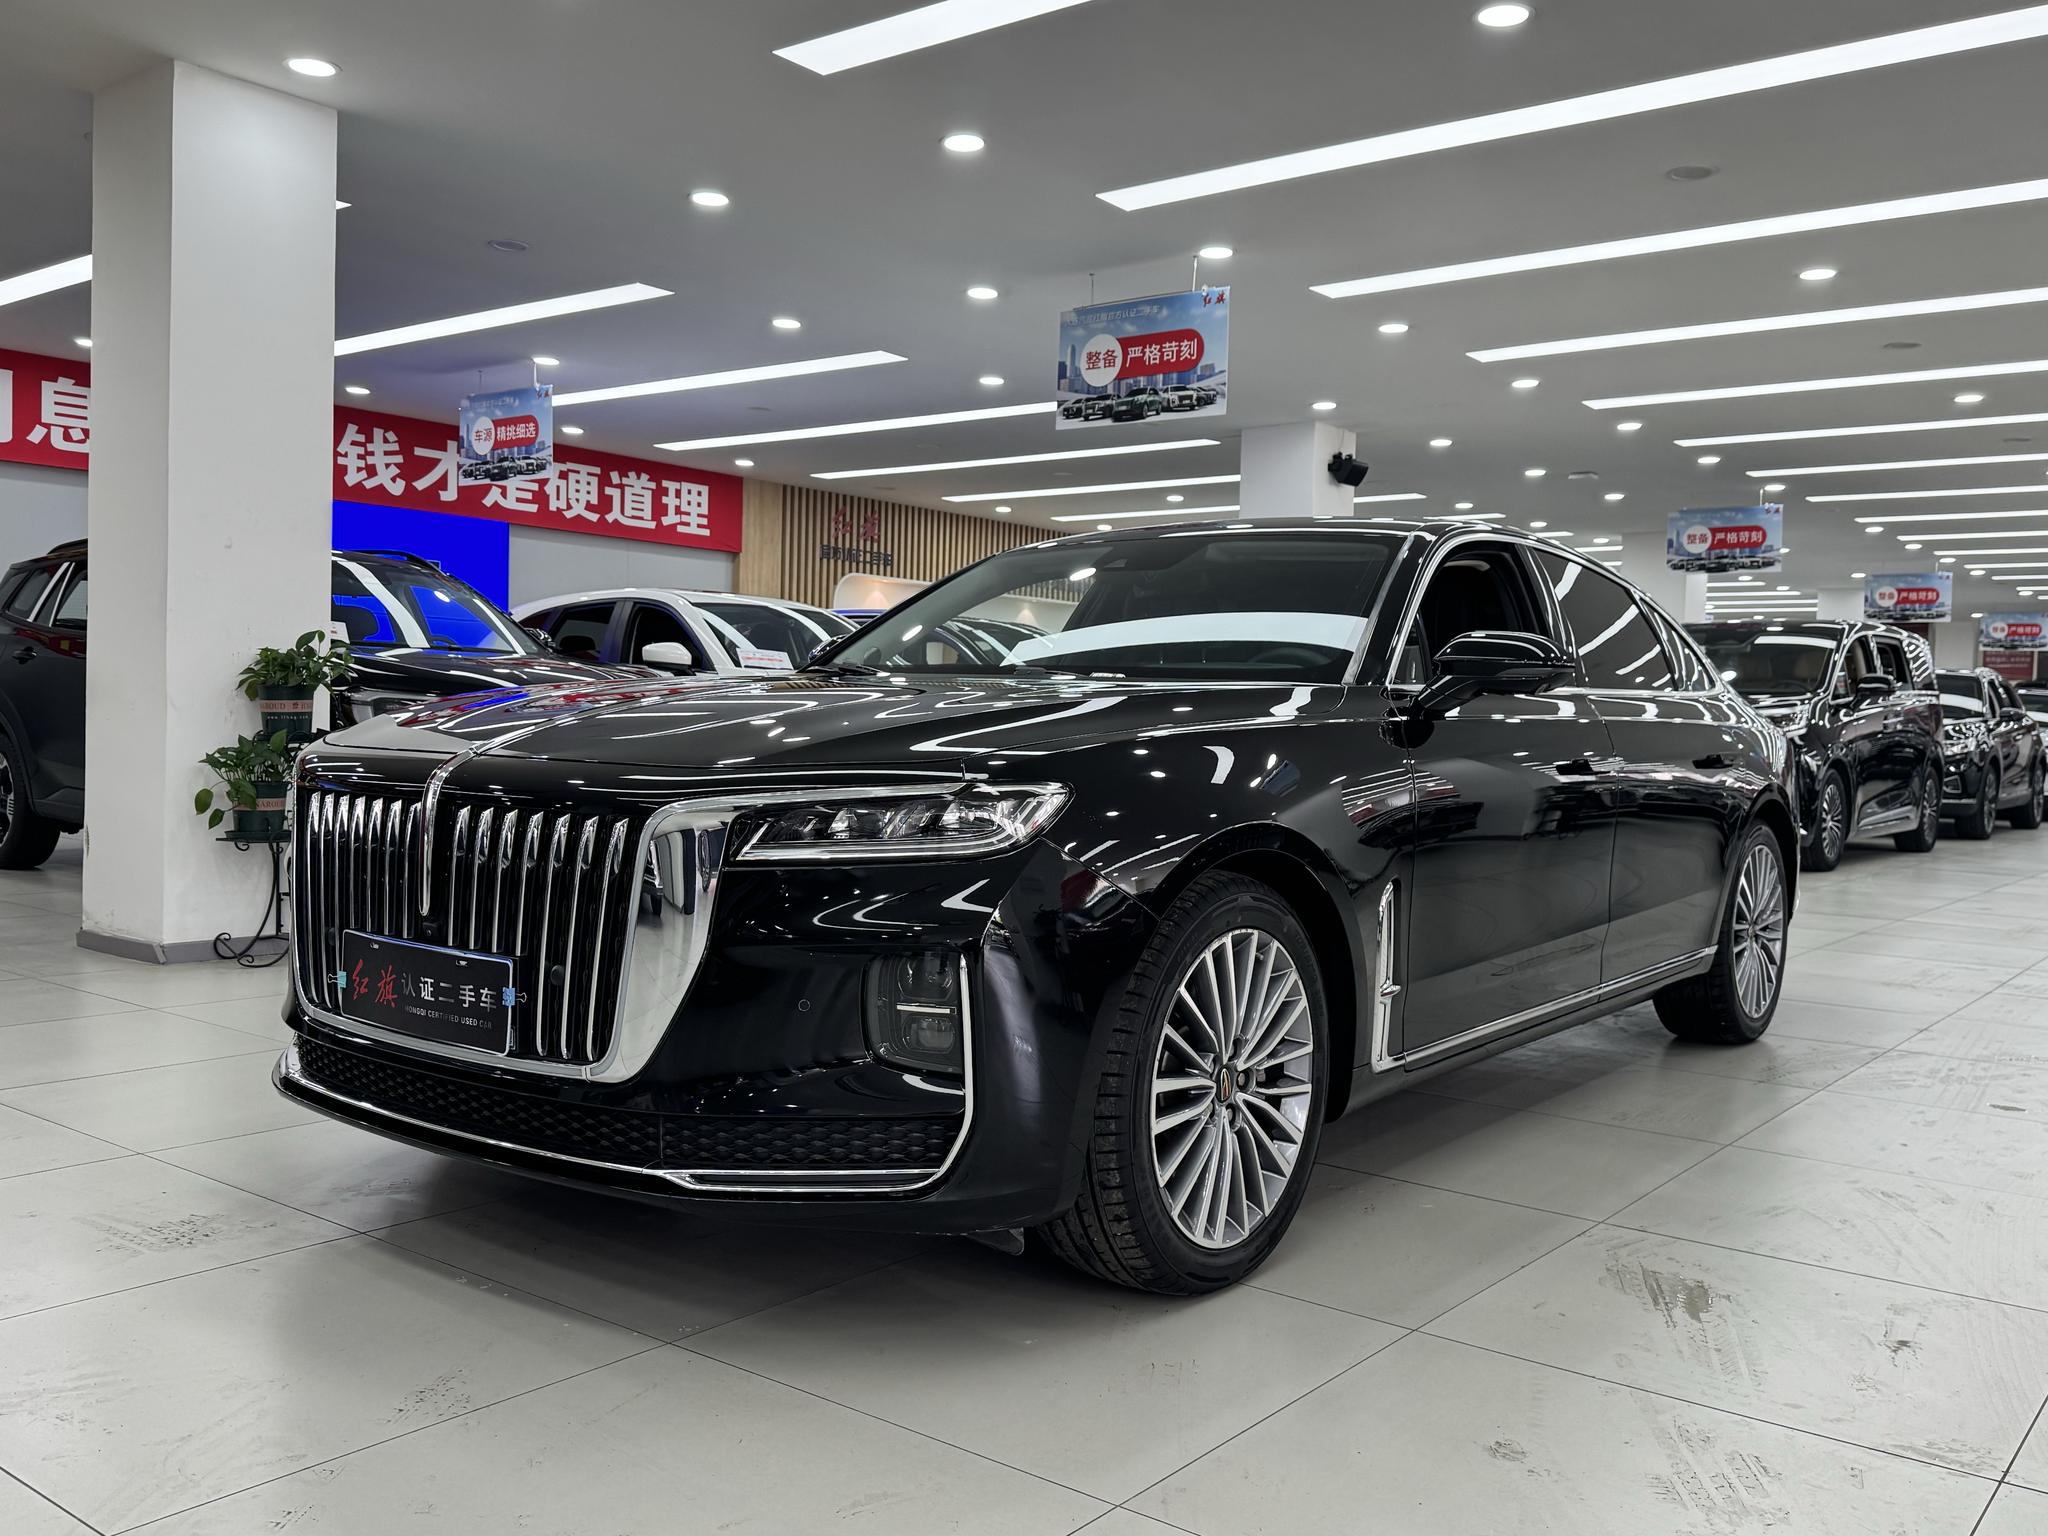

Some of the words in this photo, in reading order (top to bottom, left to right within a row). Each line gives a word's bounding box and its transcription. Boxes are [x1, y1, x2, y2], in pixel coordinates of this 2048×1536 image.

[1086, 349, 1118, 371] 整备
[1126, 338, 1198, 367] 严格苛刻
[474, 427, 493, 444] 车源
[496, 420, 537, 442] 精挑细选
[401, 972, 497, 1012] 认证二手车
[405, 1005, 427, 1016] HONGQI
[428, 1010, 459, 1023] CERTIFIED
[460, 1017, 478, 1027] USED
[479, 1020, 492, 1029] CAR
